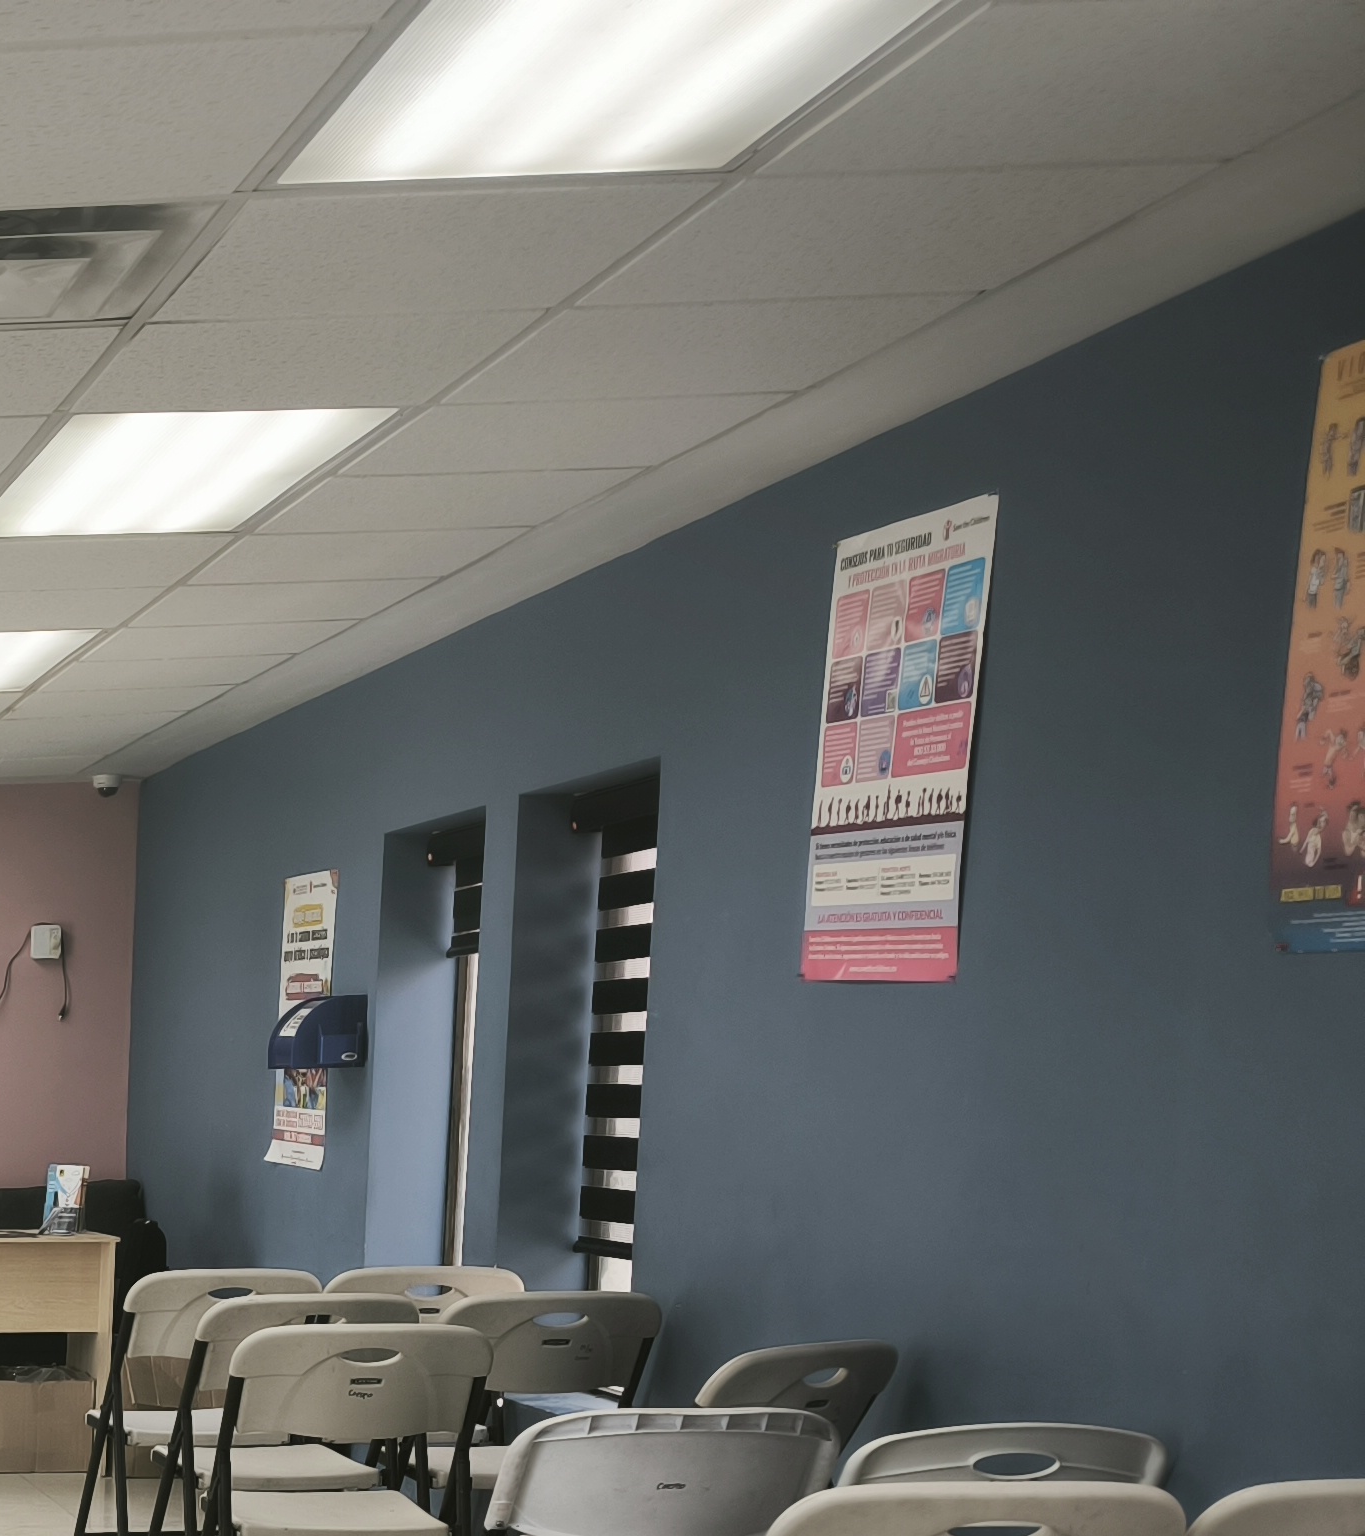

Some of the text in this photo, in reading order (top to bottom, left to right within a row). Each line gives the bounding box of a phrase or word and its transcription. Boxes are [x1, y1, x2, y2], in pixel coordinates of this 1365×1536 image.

[869, 546, 885, 563] PARA
[887, 543, 894, 558] TU
[895, 532, 932, 556] SEGURIDAD
[852, 562, 890, 587] PROTECCIÓN
[909, 554, 926, 573] RUTA
[927, 542, 966, 566] MIGRATORIA
[863, 911, 891, 922] GRATUITA
[893, 911, 897, 921] Y
